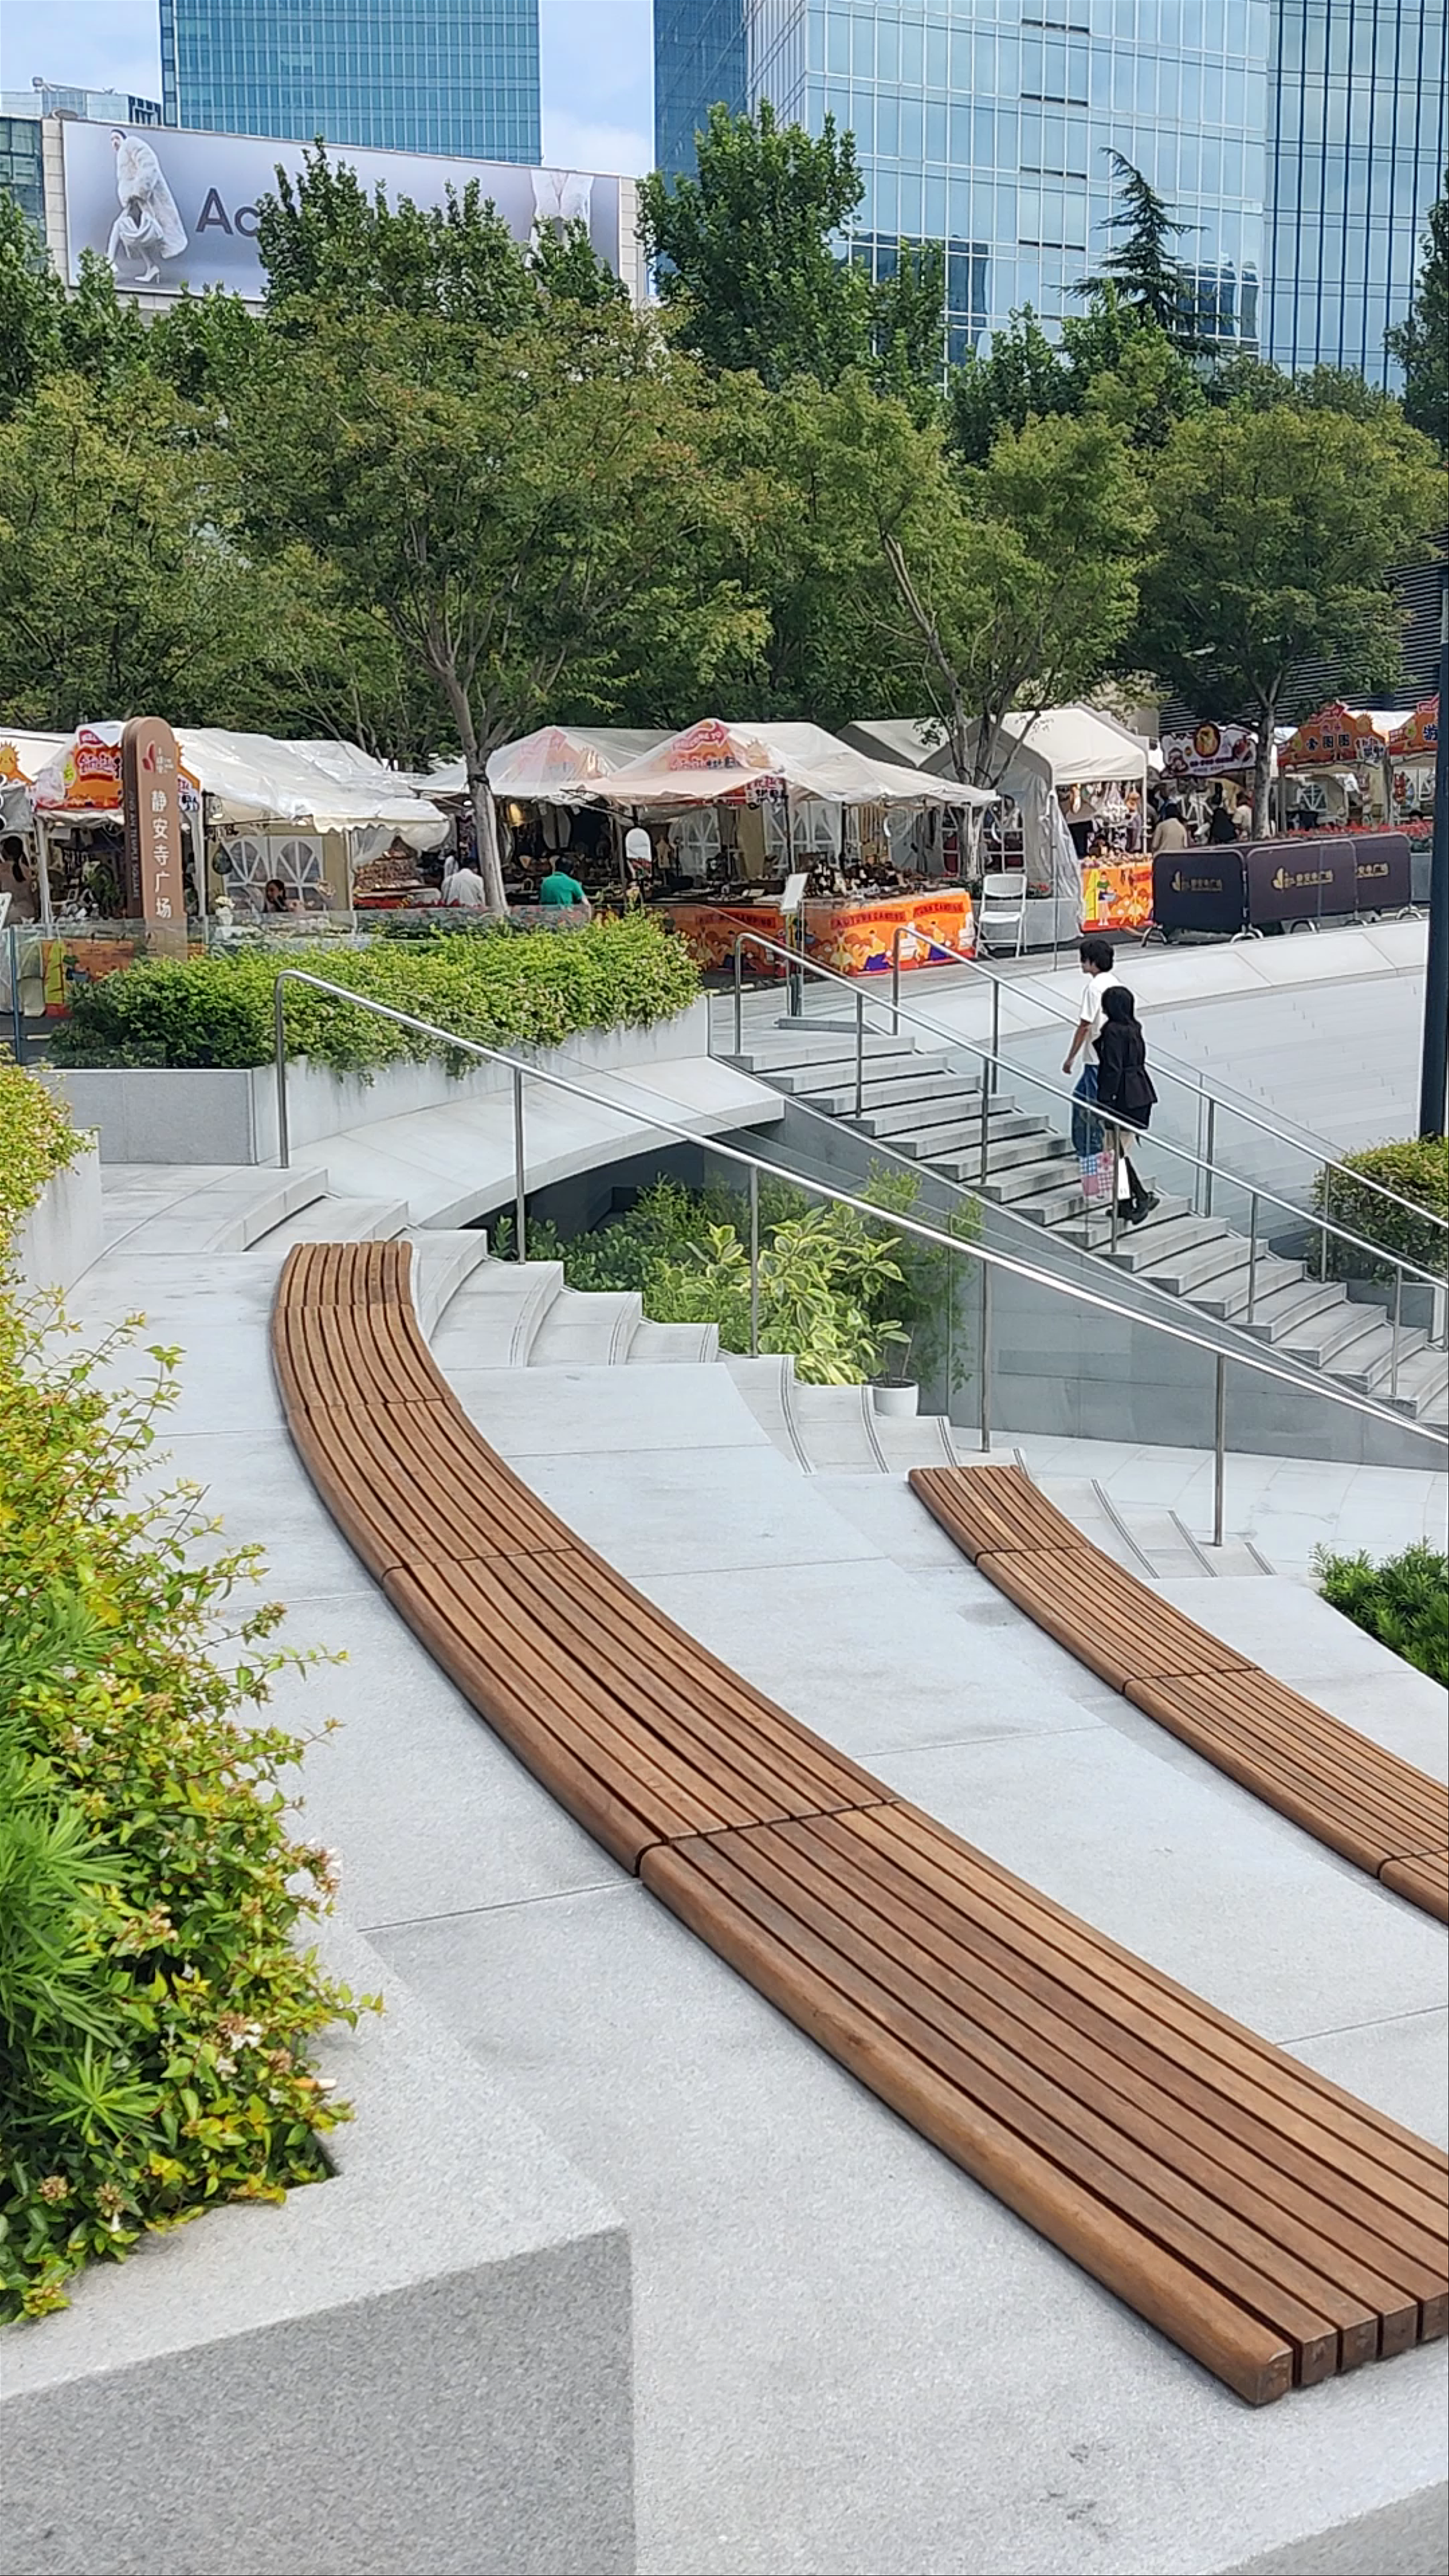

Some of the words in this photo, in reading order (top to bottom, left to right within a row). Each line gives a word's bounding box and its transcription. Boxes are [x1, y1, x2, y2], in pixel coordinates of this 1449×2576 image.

[151, 790, 172, 918] 静安寺广场
